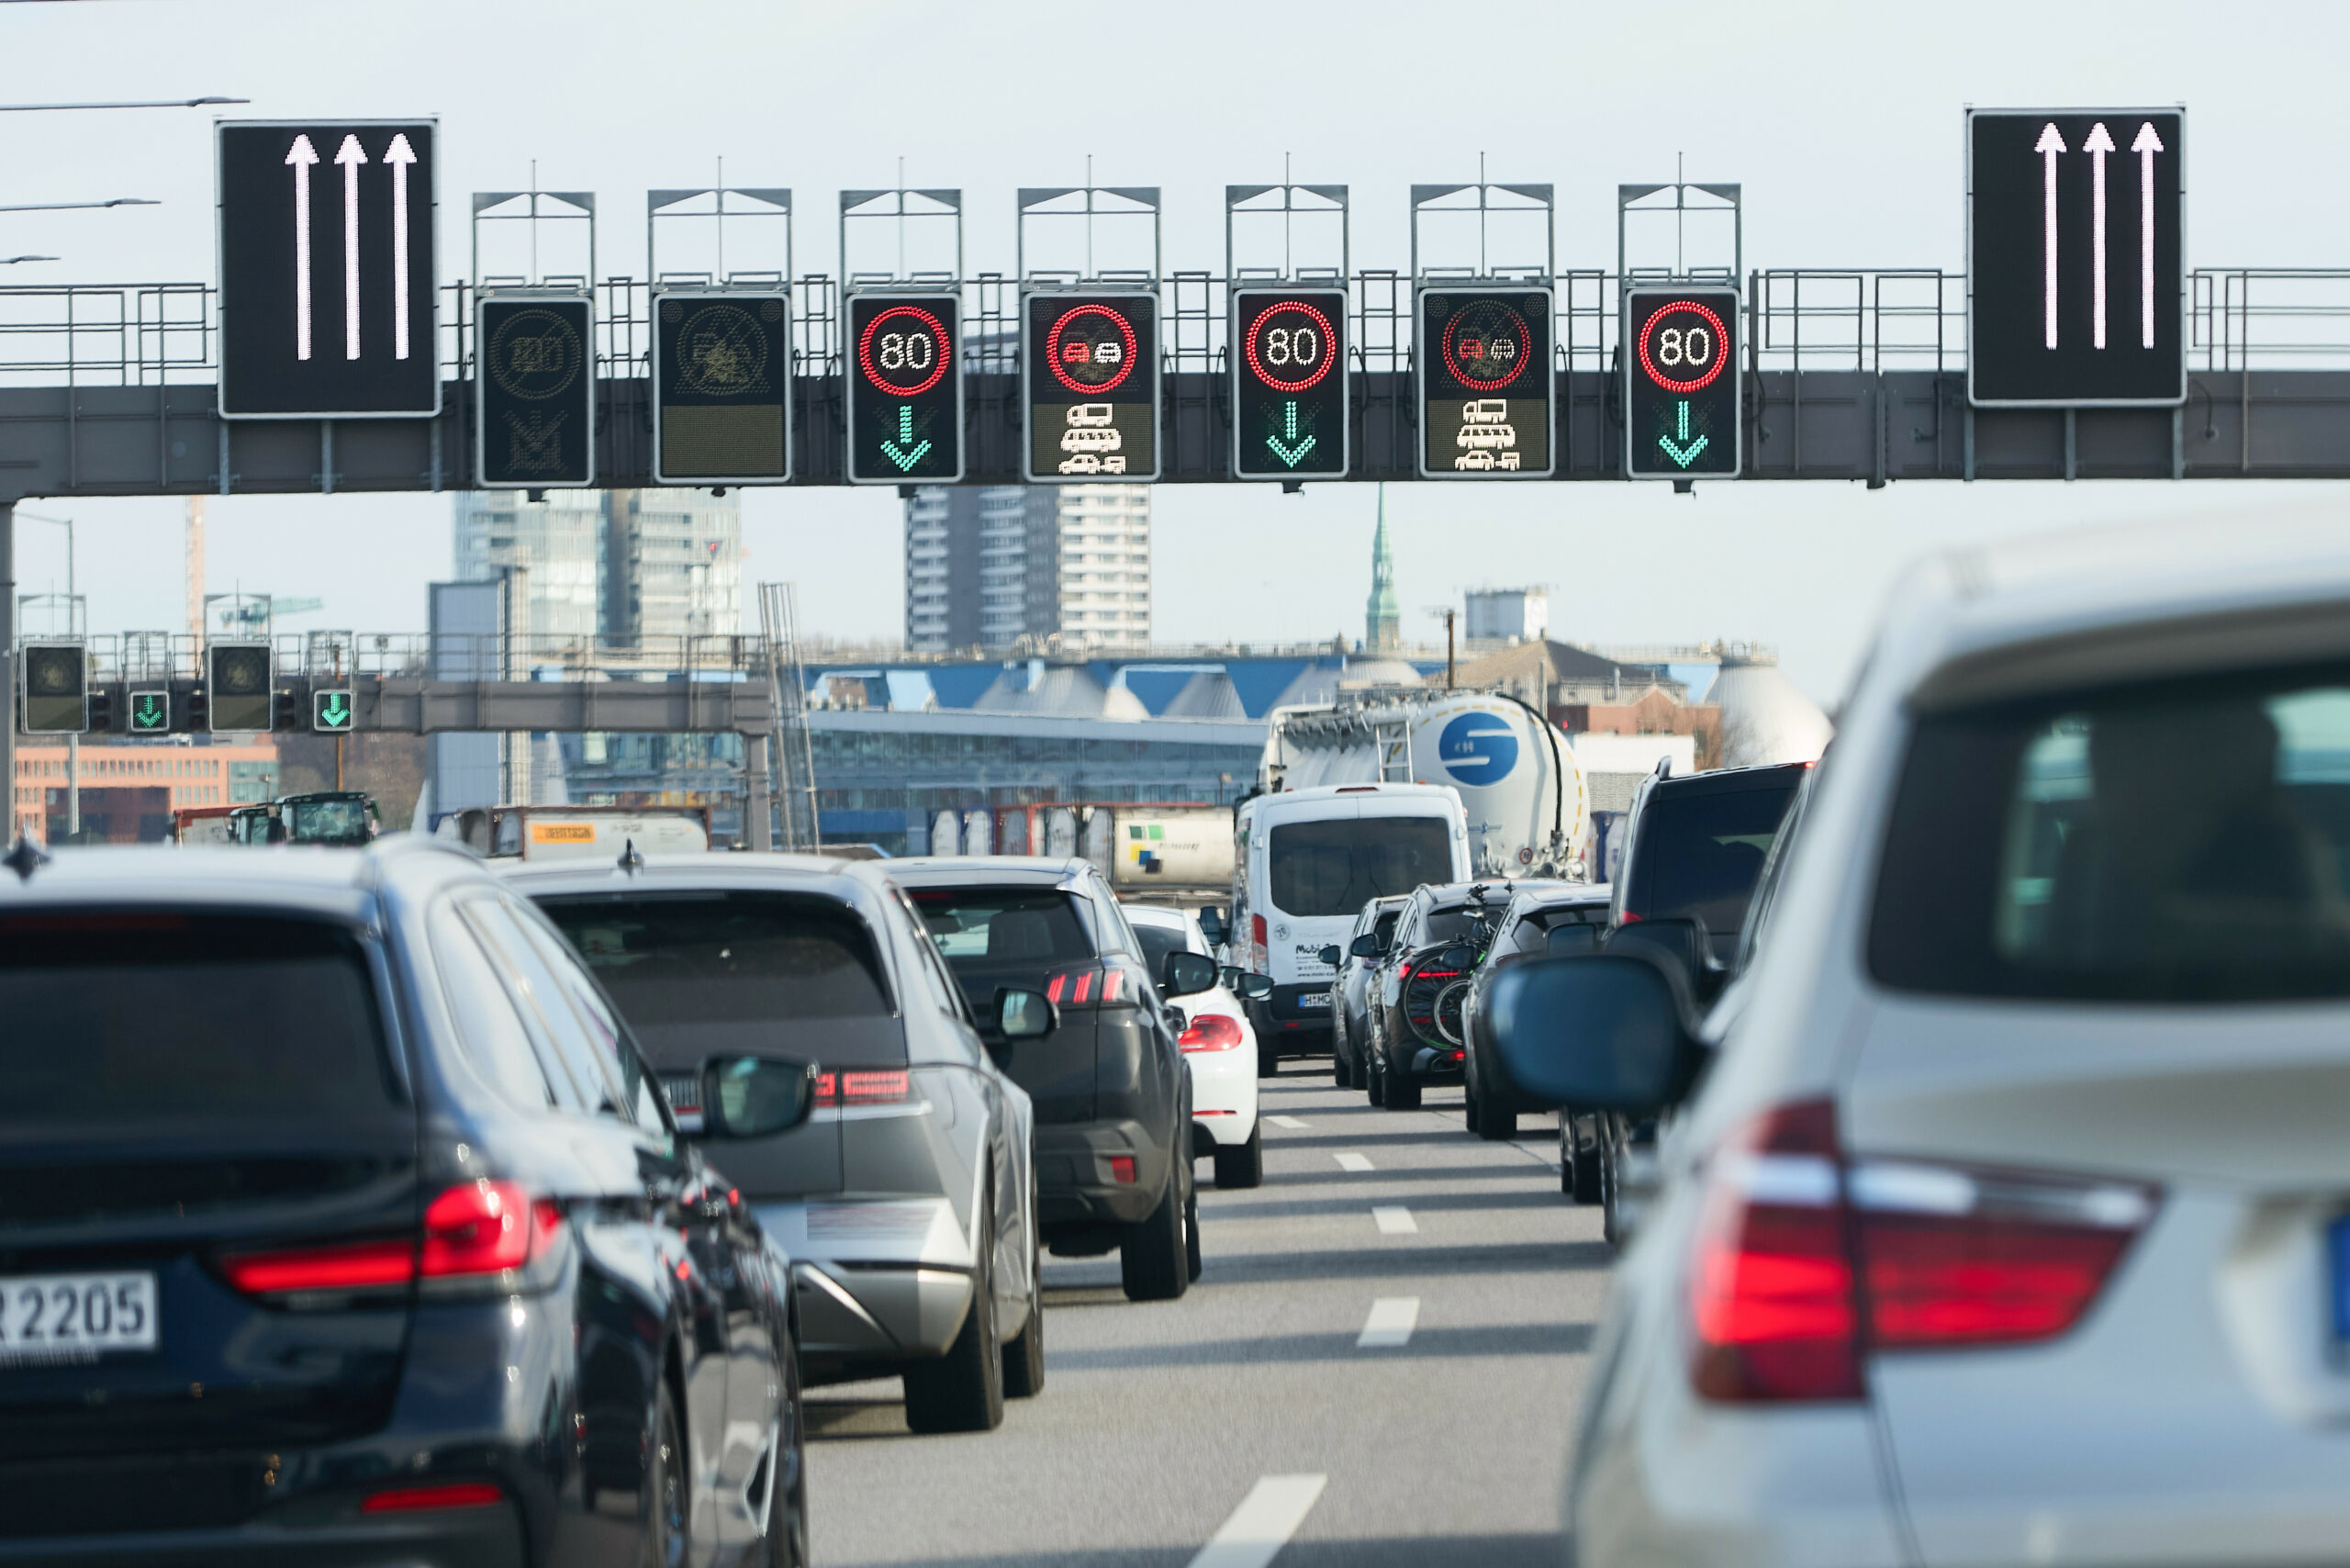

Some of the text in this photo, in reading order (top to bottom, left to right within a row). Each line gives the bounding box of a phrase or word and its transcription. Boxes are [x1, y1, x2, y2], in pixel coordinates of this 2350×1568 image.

[880, 332, 932, 370] 80
[1267, 328, 1316, 366] 80
[1660, 327, 1709, 366] 80
[19, 1282, 145, 1338] 2205
